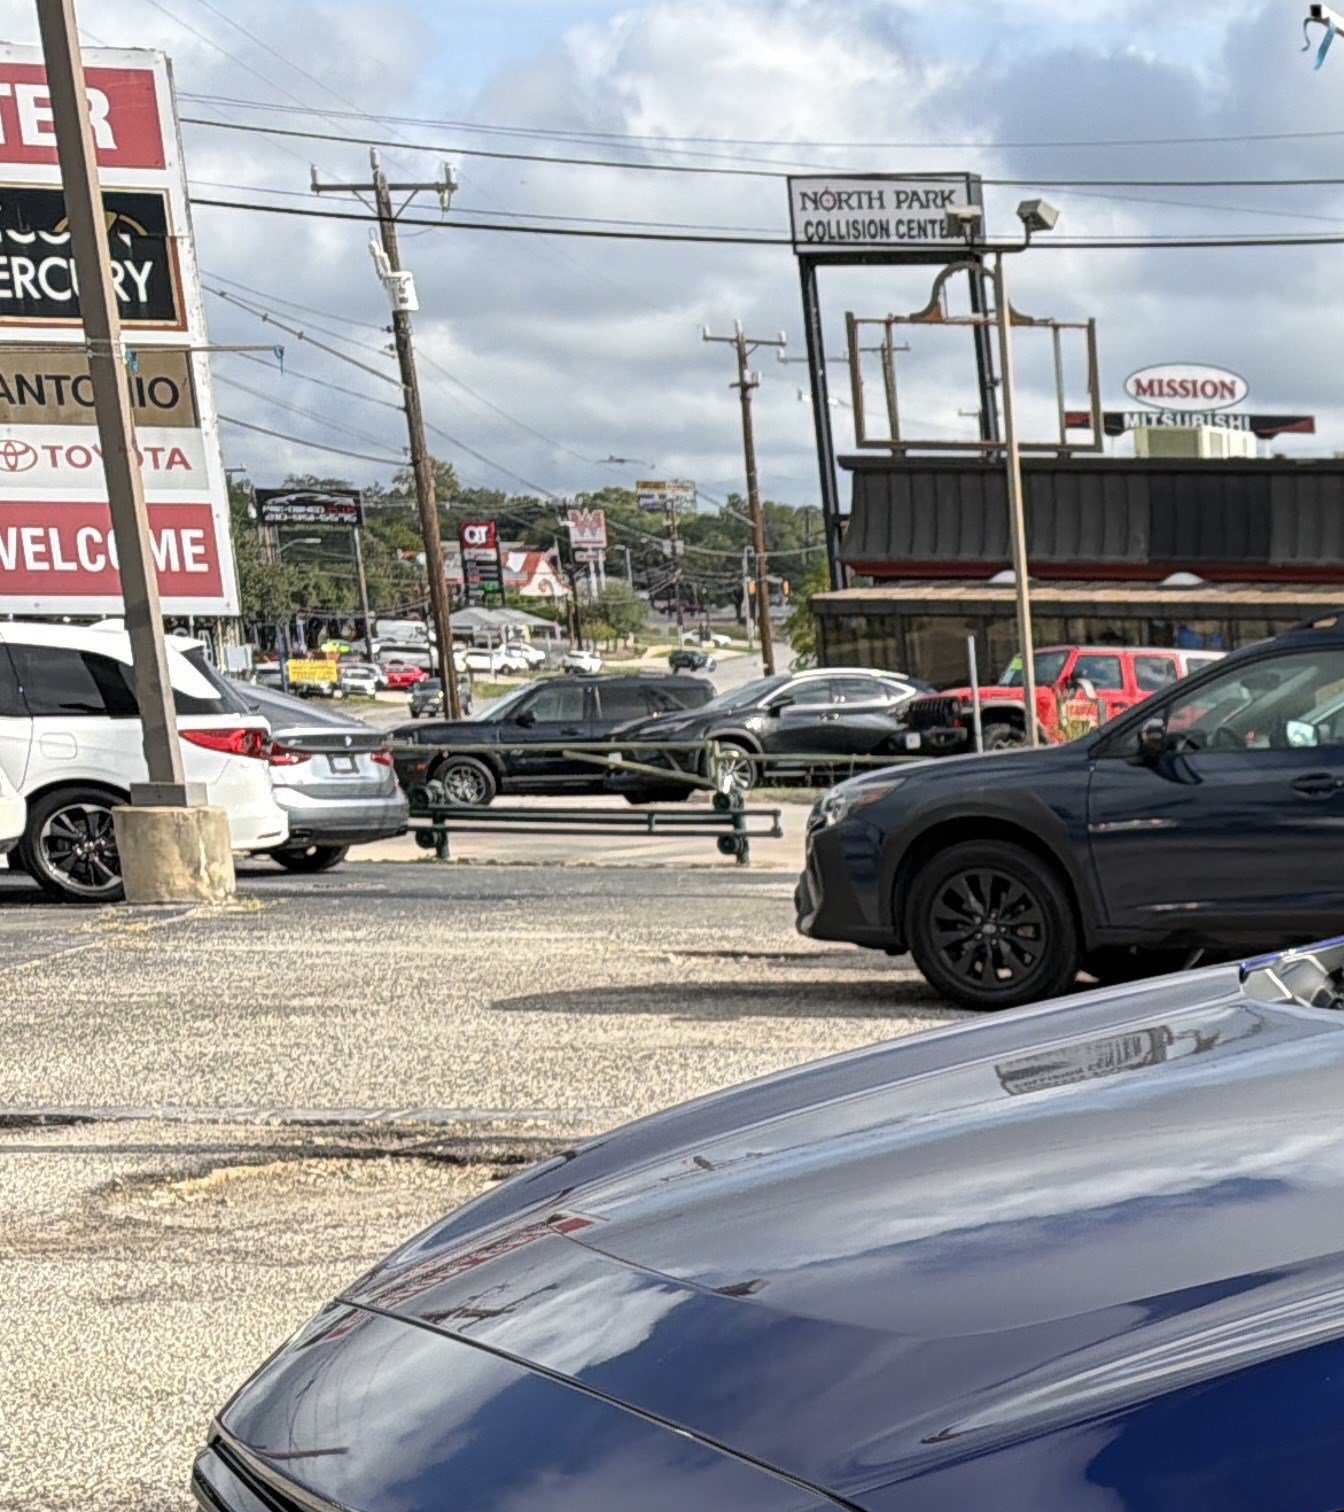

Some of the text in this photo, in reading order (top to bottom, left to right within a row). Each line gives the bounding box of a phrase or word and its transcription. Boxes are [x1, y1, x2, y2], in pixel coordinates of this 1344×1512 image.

[801, 187, 956, 211] NORTH PARK
[804, 218, 962, 241] COLLISION CENTE
[1134, 378, 1236, 400] MISSION
[41, 444, 192, 470] TOTA
